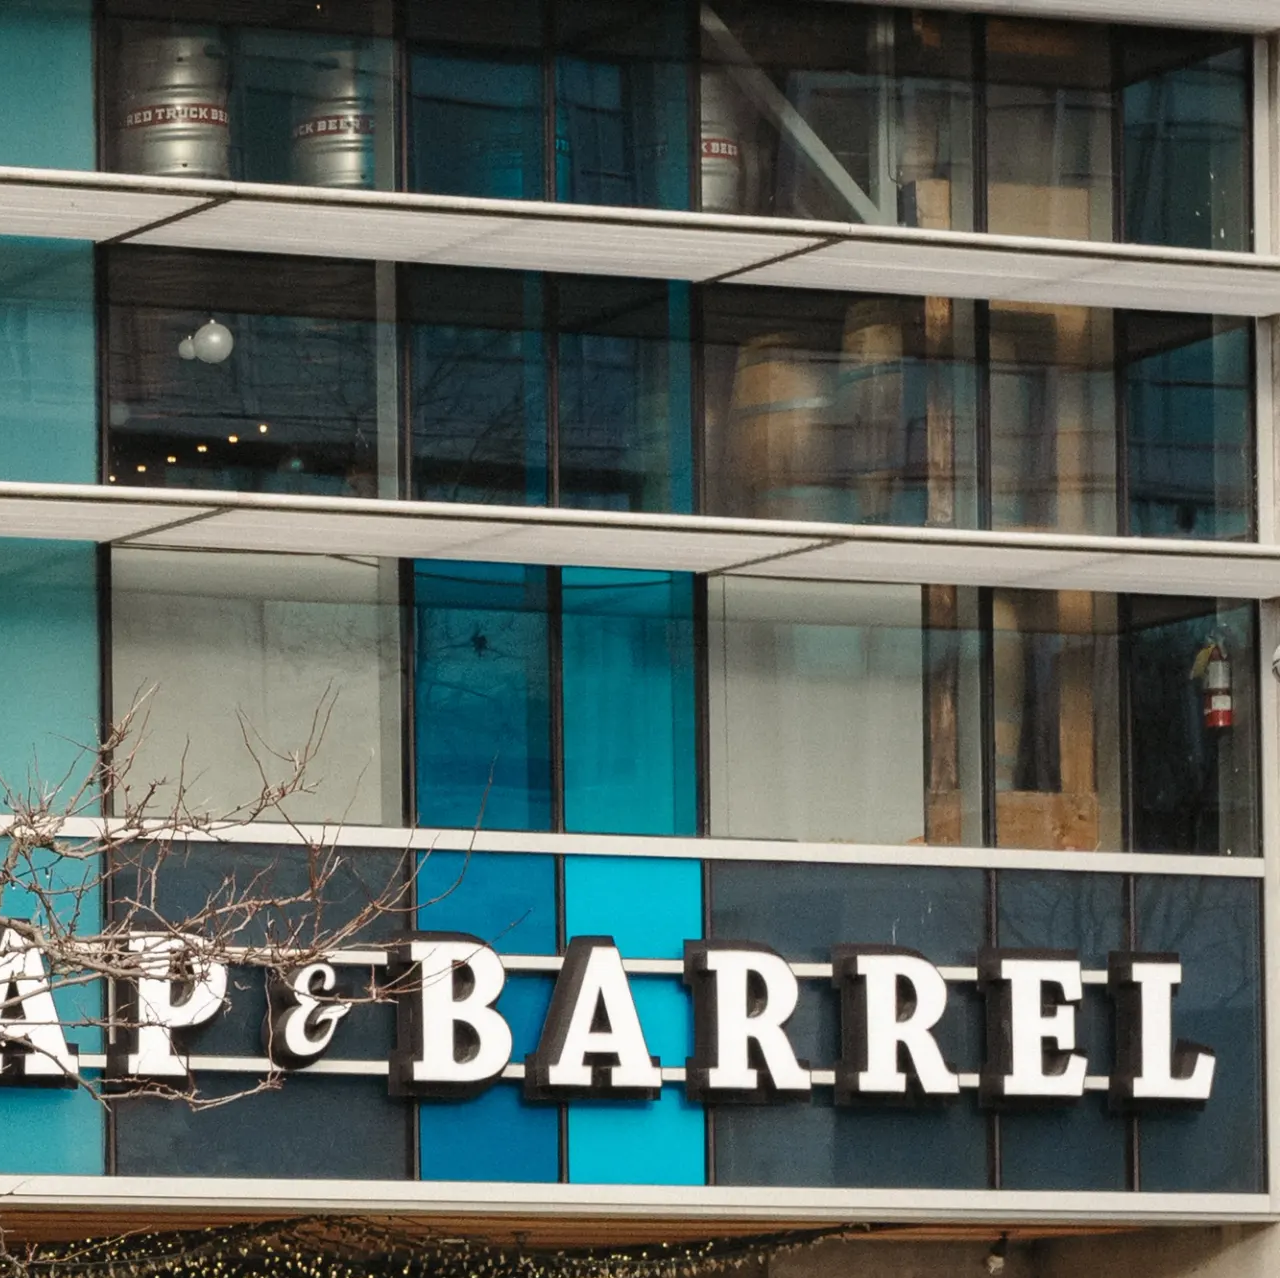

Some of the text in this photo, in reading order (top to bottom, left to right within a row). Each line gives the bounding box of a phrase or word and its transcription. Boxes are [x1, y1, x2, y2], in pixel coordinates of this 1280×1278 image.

[126, 110, 153, 126] RED
[155, 107, 208, 119] TRUCK
[317, 119, 361, 132] BEER
[282, 960, 352, 1057] &
[410, 938, 1217, 1100] BARREL
